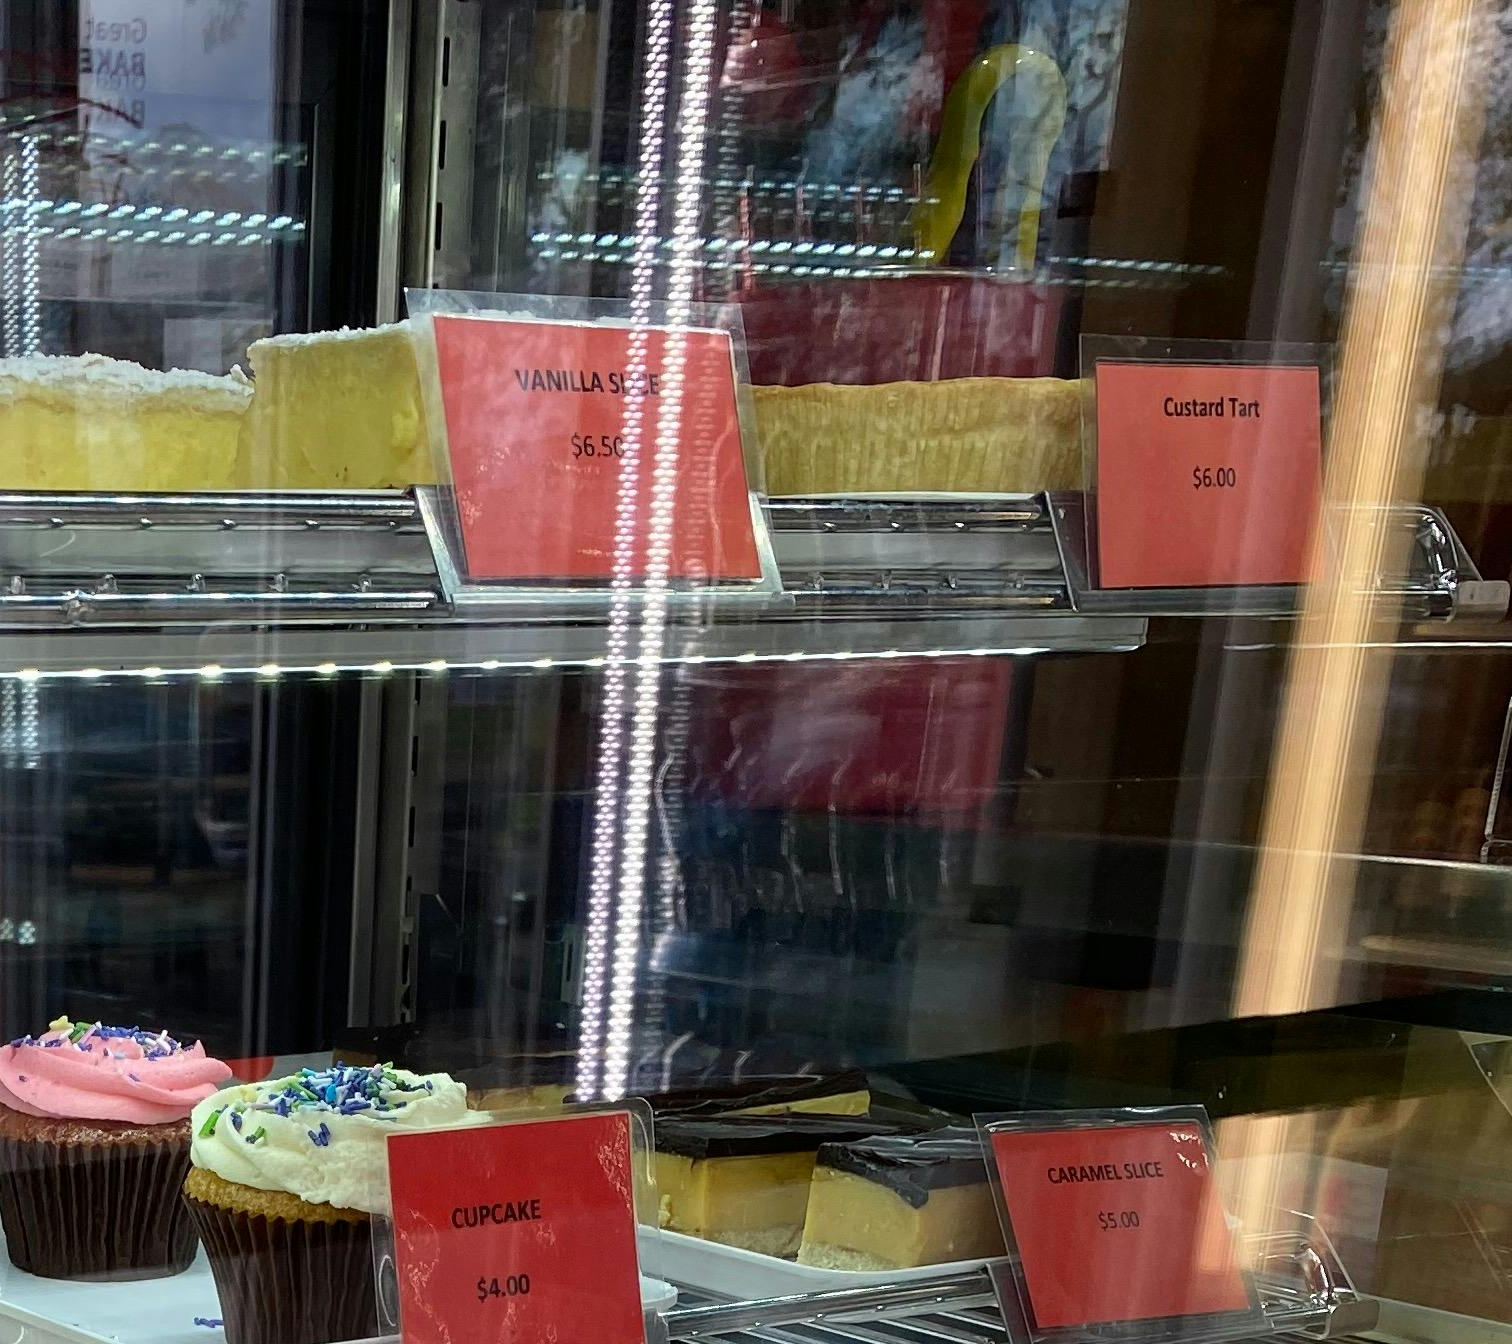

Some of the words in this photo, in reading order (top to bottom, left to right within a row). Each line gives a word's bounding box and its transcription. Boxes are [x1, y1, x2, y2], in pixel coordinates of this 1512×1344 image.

[514, 369, 605, 393] VANILLA
[1164, 396, 1225, 417] Custard
[1228, 398, 1260, 418] Tart
[571, 432, 627, 460] $6.50
[1192, 465, 1236, 491] $6.00
[1047, 1164, 1123, 1184] CARAMEL
[1124, 1161, 1164, 1180] SLICE
[451, 1199, 542, 1229] CUPCAKE
[1098, 1210, 1140, 1232] $5.00
[477, 1273, 530, 1303] $4.00
